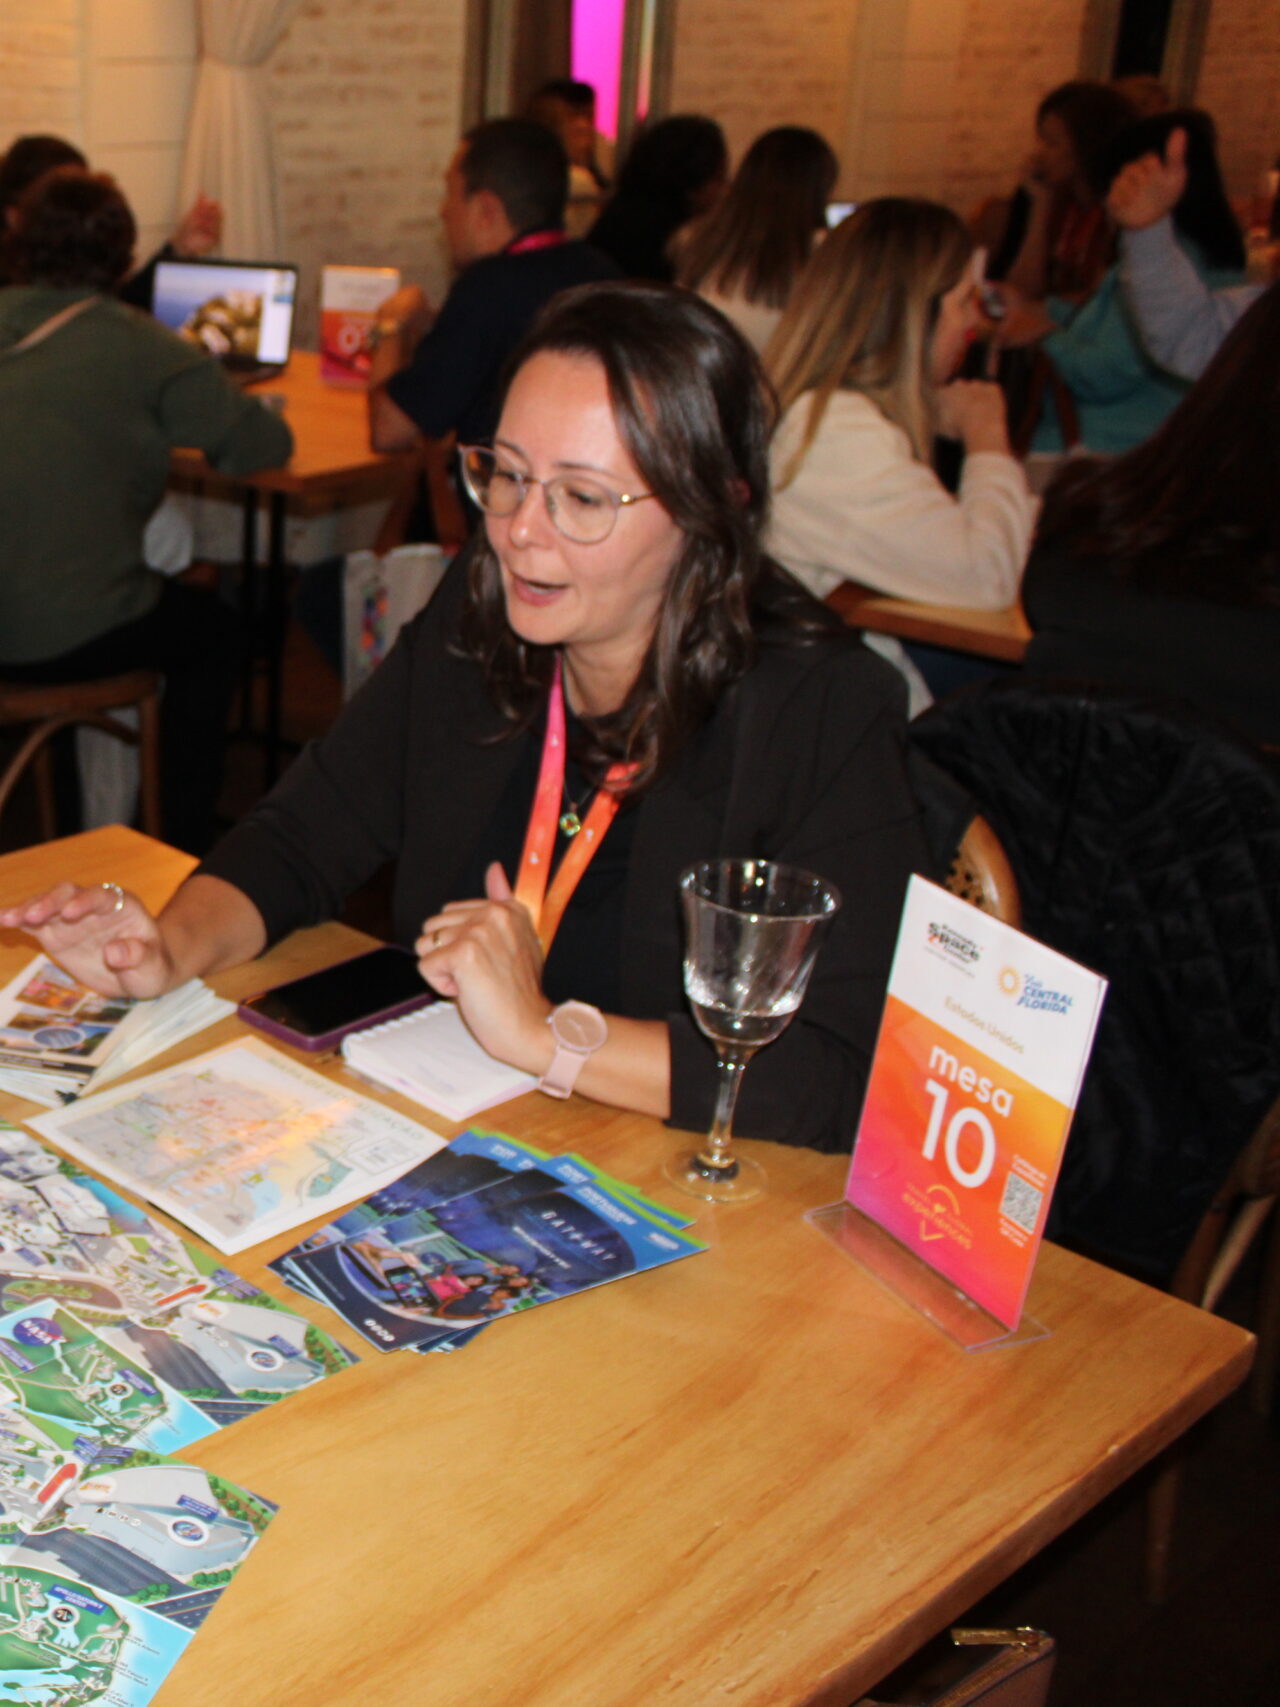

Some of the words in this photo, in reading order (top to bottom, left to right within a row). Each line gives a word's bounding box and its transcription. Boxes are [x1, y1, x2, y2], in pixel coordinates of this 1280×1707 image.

[1017, 996, 1068, 1015] FLORIDA
[1023, 985, 1073, 1006] CENTRAL
[944, 995, 986, 1031] Estados
[986, 1022, 1024, 1054] Unidos
[928, 1045, 1014, 1118] mesa
[922, 1079, 995, 1188] 10
[20, 1319, 55, 1345] NASA
